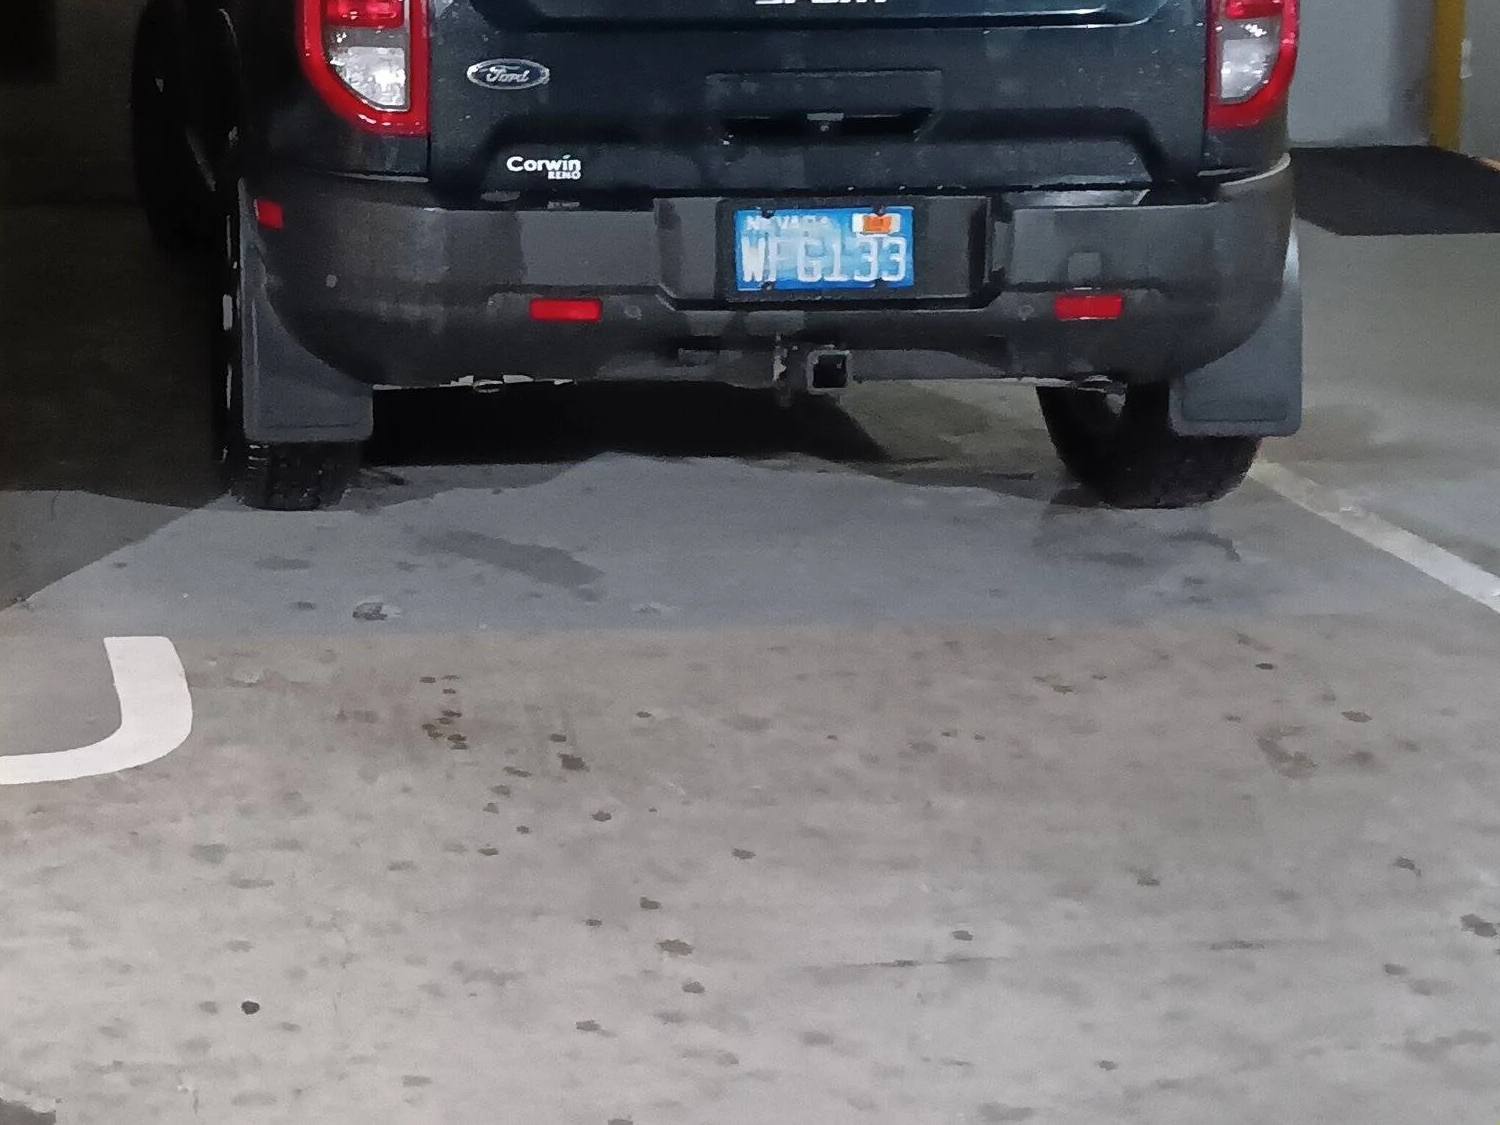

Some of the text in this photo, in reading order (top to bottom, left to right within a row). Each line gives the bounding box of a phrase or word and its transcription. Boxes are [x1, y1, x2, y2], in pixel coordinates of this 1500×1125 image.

[479, 65, 530, 82] Ford
[506, 154, 581, 172] Corwin
[547, 171, 581, 180] RENO
[745, 215, 831, 231] NVAA
